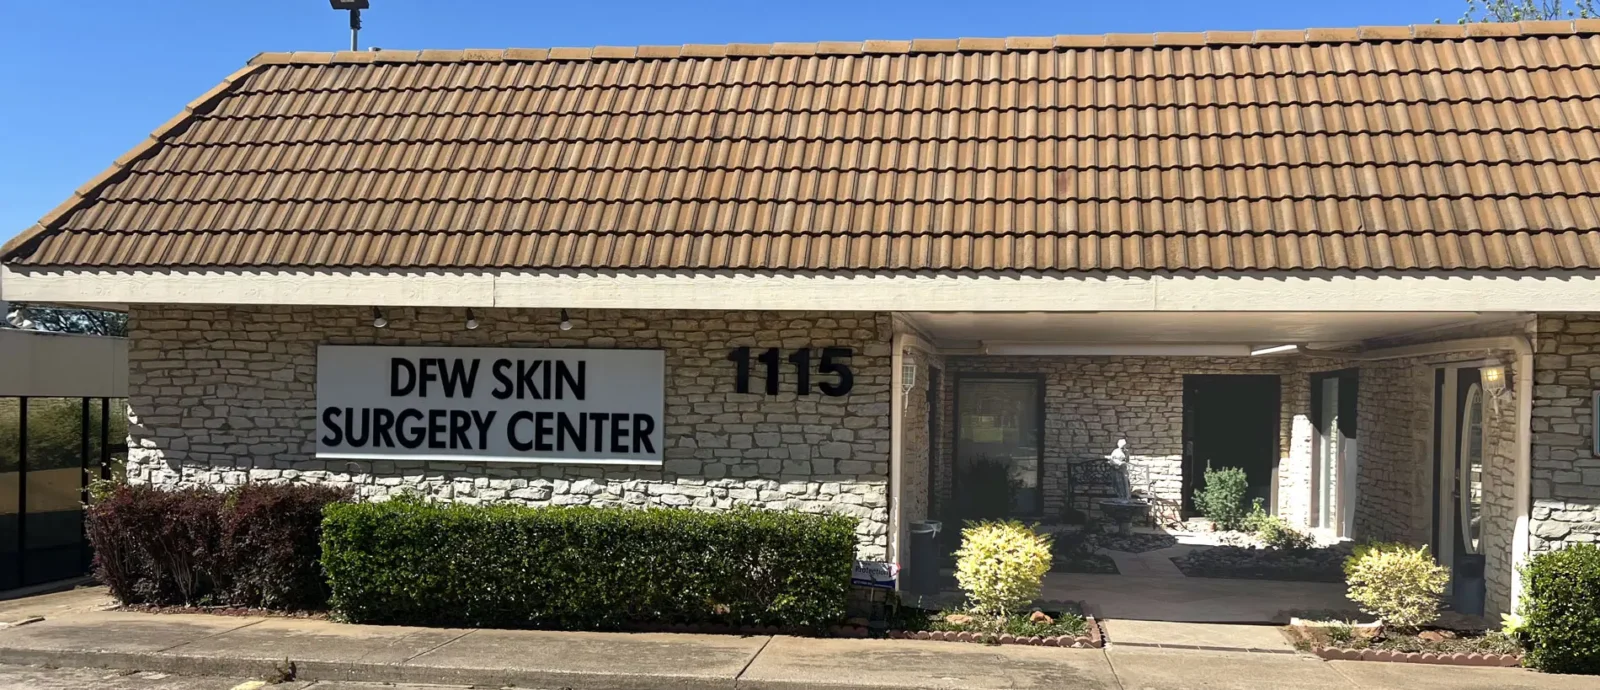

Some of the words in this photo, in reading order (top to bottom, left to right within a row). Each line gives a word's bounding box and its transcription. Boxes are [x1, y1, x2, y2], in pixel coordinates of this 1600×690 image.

[390, 357, 481, 399] DFW
[491, 358, 586, 401] SKIN
[727, 347, 854, 397] 1115
[321, 406, 497, 451] SURGERY
[507, 410, 656, 454] CENTER
